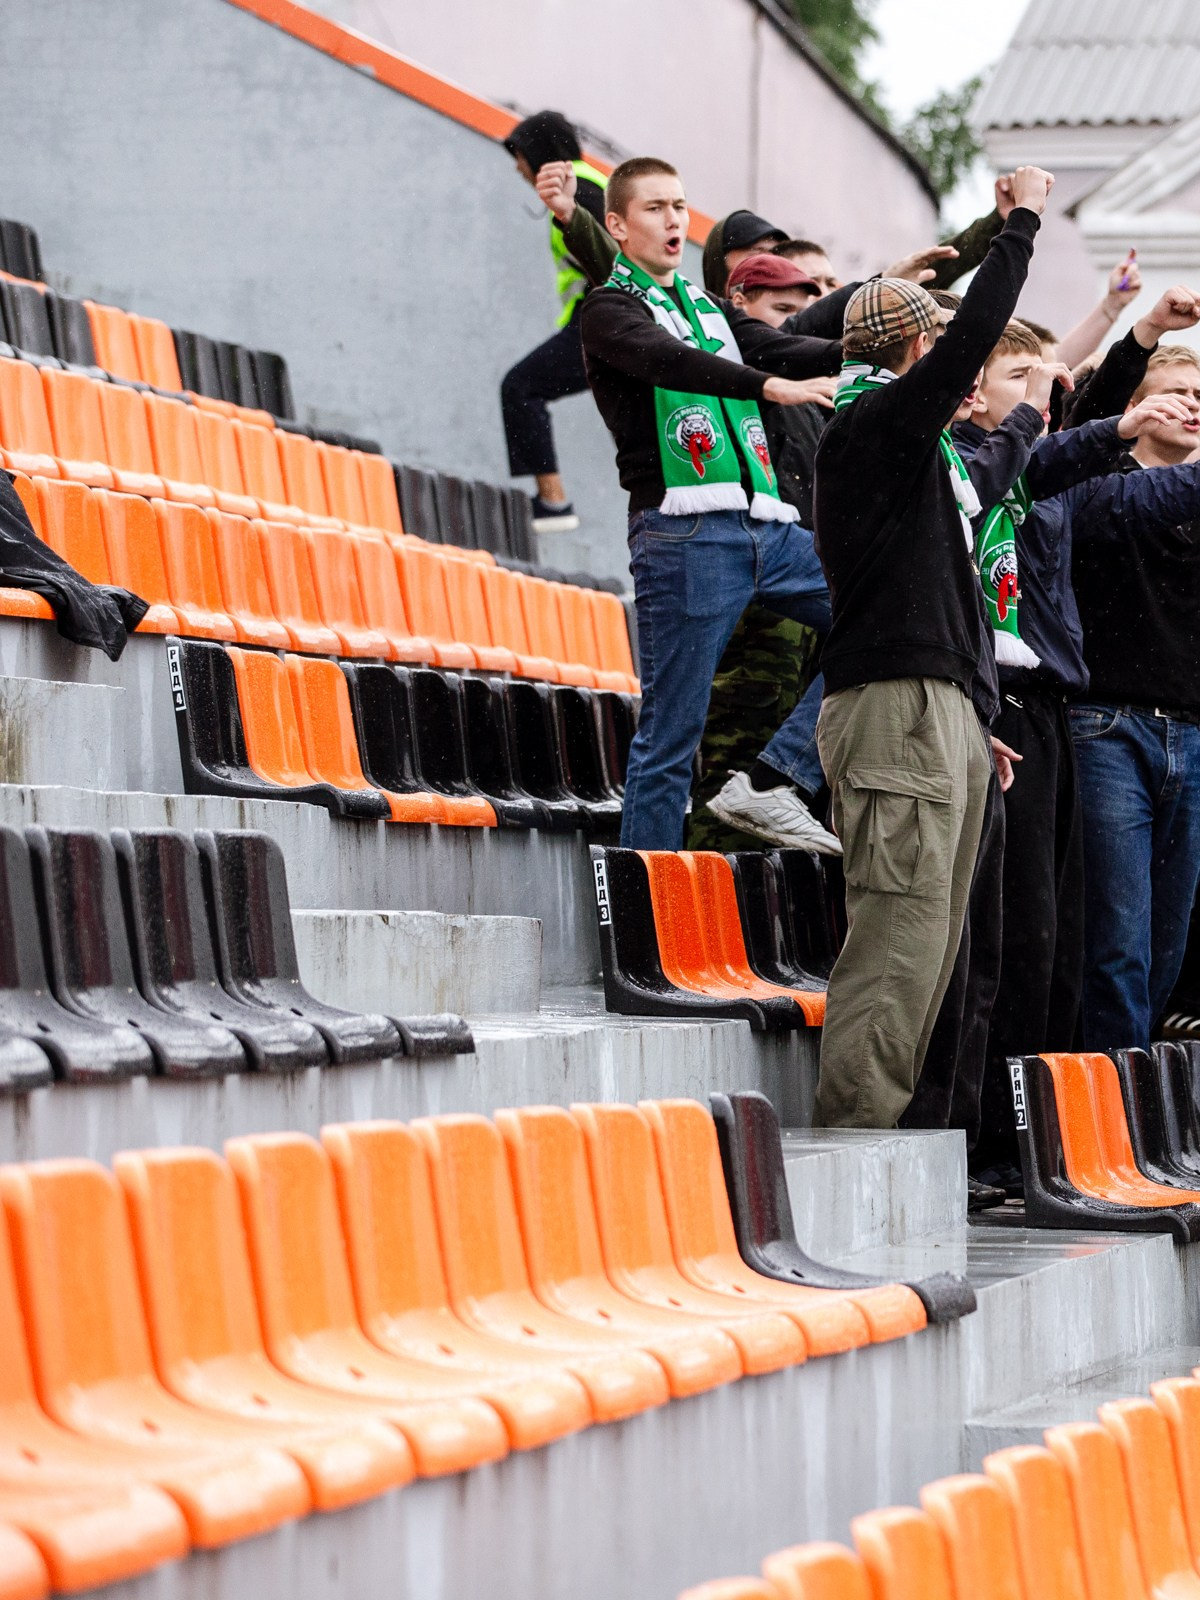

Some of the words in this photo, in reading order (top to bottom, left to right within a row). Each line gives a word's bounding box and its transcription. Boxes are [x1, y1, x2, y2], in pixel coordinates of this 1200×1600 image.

[170, 649, 181, 688] РЯД
[596, 862, 607, 902] РЯД
[1013, 1067, 1024, 1107] РЯД
